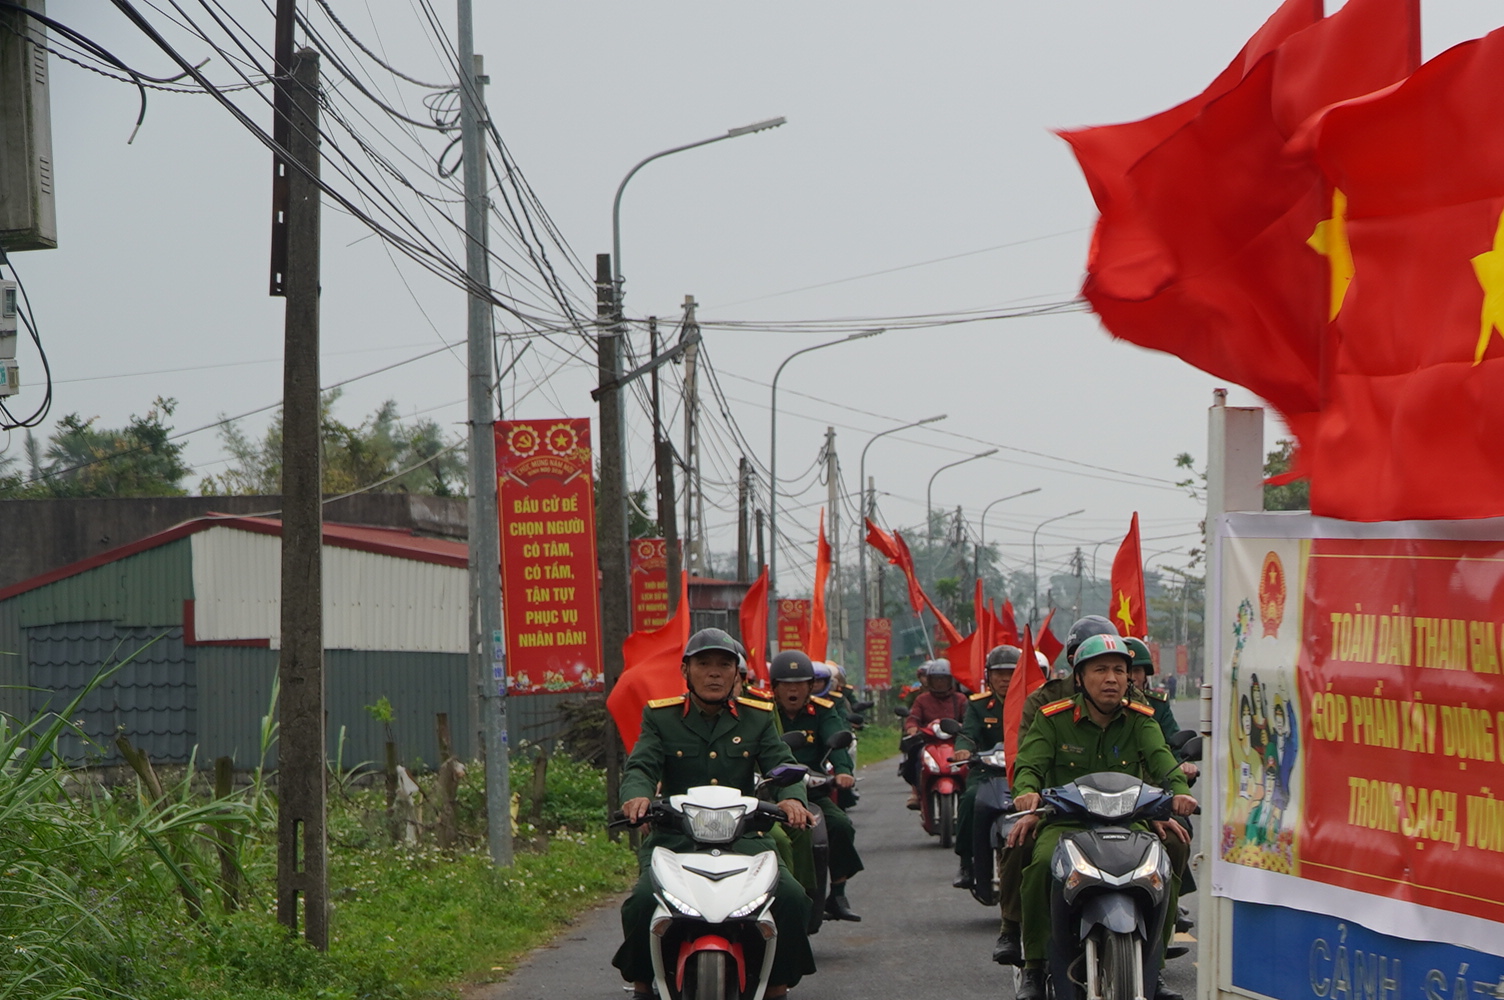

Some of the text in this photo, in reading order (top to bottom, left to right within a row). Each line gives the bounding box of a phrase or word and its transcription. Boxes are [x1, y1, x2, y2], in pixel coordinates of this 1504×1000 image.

[513, 493, 578, 513] BẦU CỬ ĐỂ
[509, 516, 585, 538] CHỌN NGƯỜI
[523, 540, 574, 558] CÓ TÂM,
[524, 561, 575, 580] CÓ TẦM,
[525, 585, 575, 605] TẬN TỤY
[525, 609, 578, 627] PHỤC VỤ
[518, 629, 587, 647] NHÂN DÂN!
[1330, 603, 1376, 663] TOÀN
[1376, 605, 1411, 666] DÂN
[1413, 617, 1467, 671] THAM
[1469, 620, 1500, 675] GIA
[1312, 682, 1349, 741] GÓP
[1350, 680, 1400, 749] PHẦN
[1400, 691, 1437, 754] XÂY
[1440, 702, 1495, 770] DỰNG
[1348, 776, 1402, 833] TRONG
[1402, 785, 1461, 851] SẠCH,
